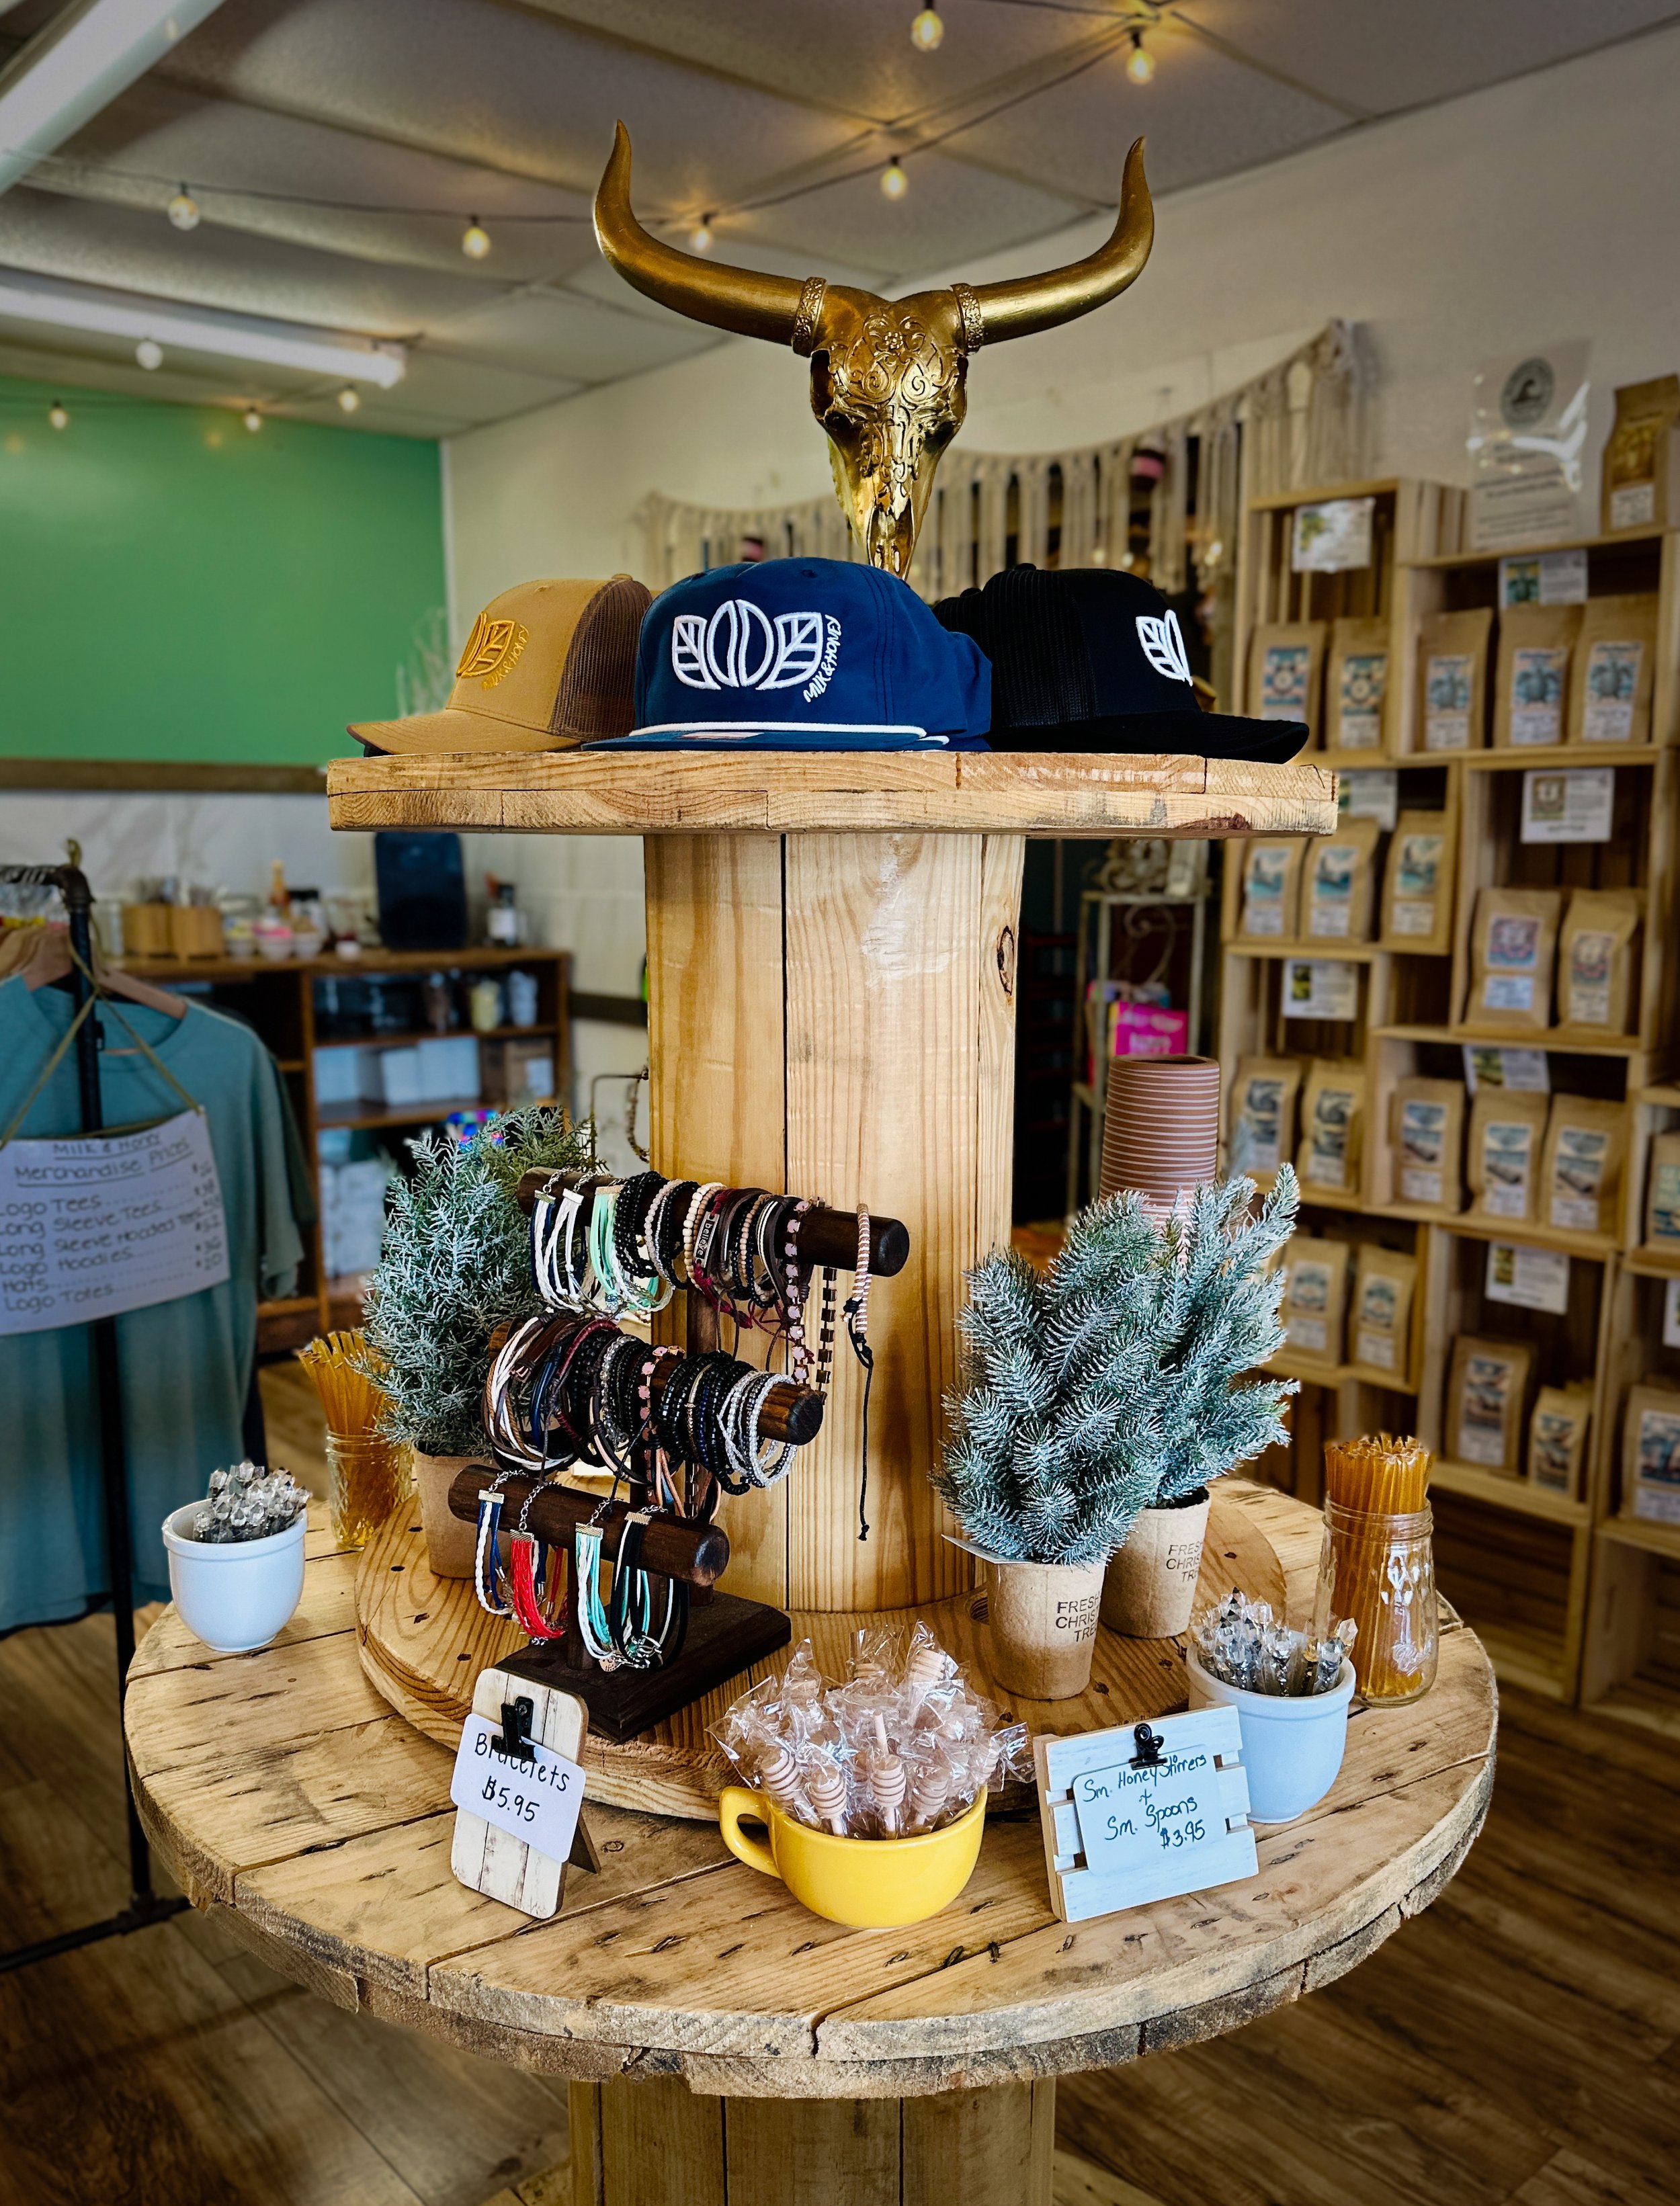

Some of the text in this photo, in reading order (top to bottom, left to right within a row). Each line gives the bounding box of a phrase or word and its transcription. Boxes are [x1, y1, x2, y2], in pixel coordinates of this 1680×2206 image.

[54, 1143, 97, 1154] Milk
[0, 1201, 47, 1221] ogo
[50, 1195, 101, 1214] Tees
[0, 1220, 46, 1240] ong
[53, 1214, 120, 1232] Sleeve
[122, 1200, 161, 1220] Tees
[54, 1234, 112, 1253] Sleeve
[698, 1223, 713, 1256] believe
[0, 1261, 48, 1279] Logo
[2, 1278, 48, 1294] Hats
[4, 1294, 55, 1314] Logo
[1056, 1607, 1098, 1629] CHRIS
[1075, 1622, 1097, 1642] TRE
[482, 1775, 540, 1822] $5.95
[1083, 1779, 1114, 1802] Sm.
[1104, 1796, 1198, 1840] Sm. Spoons
[1160, 1819, 1206, 1849] $3.95
